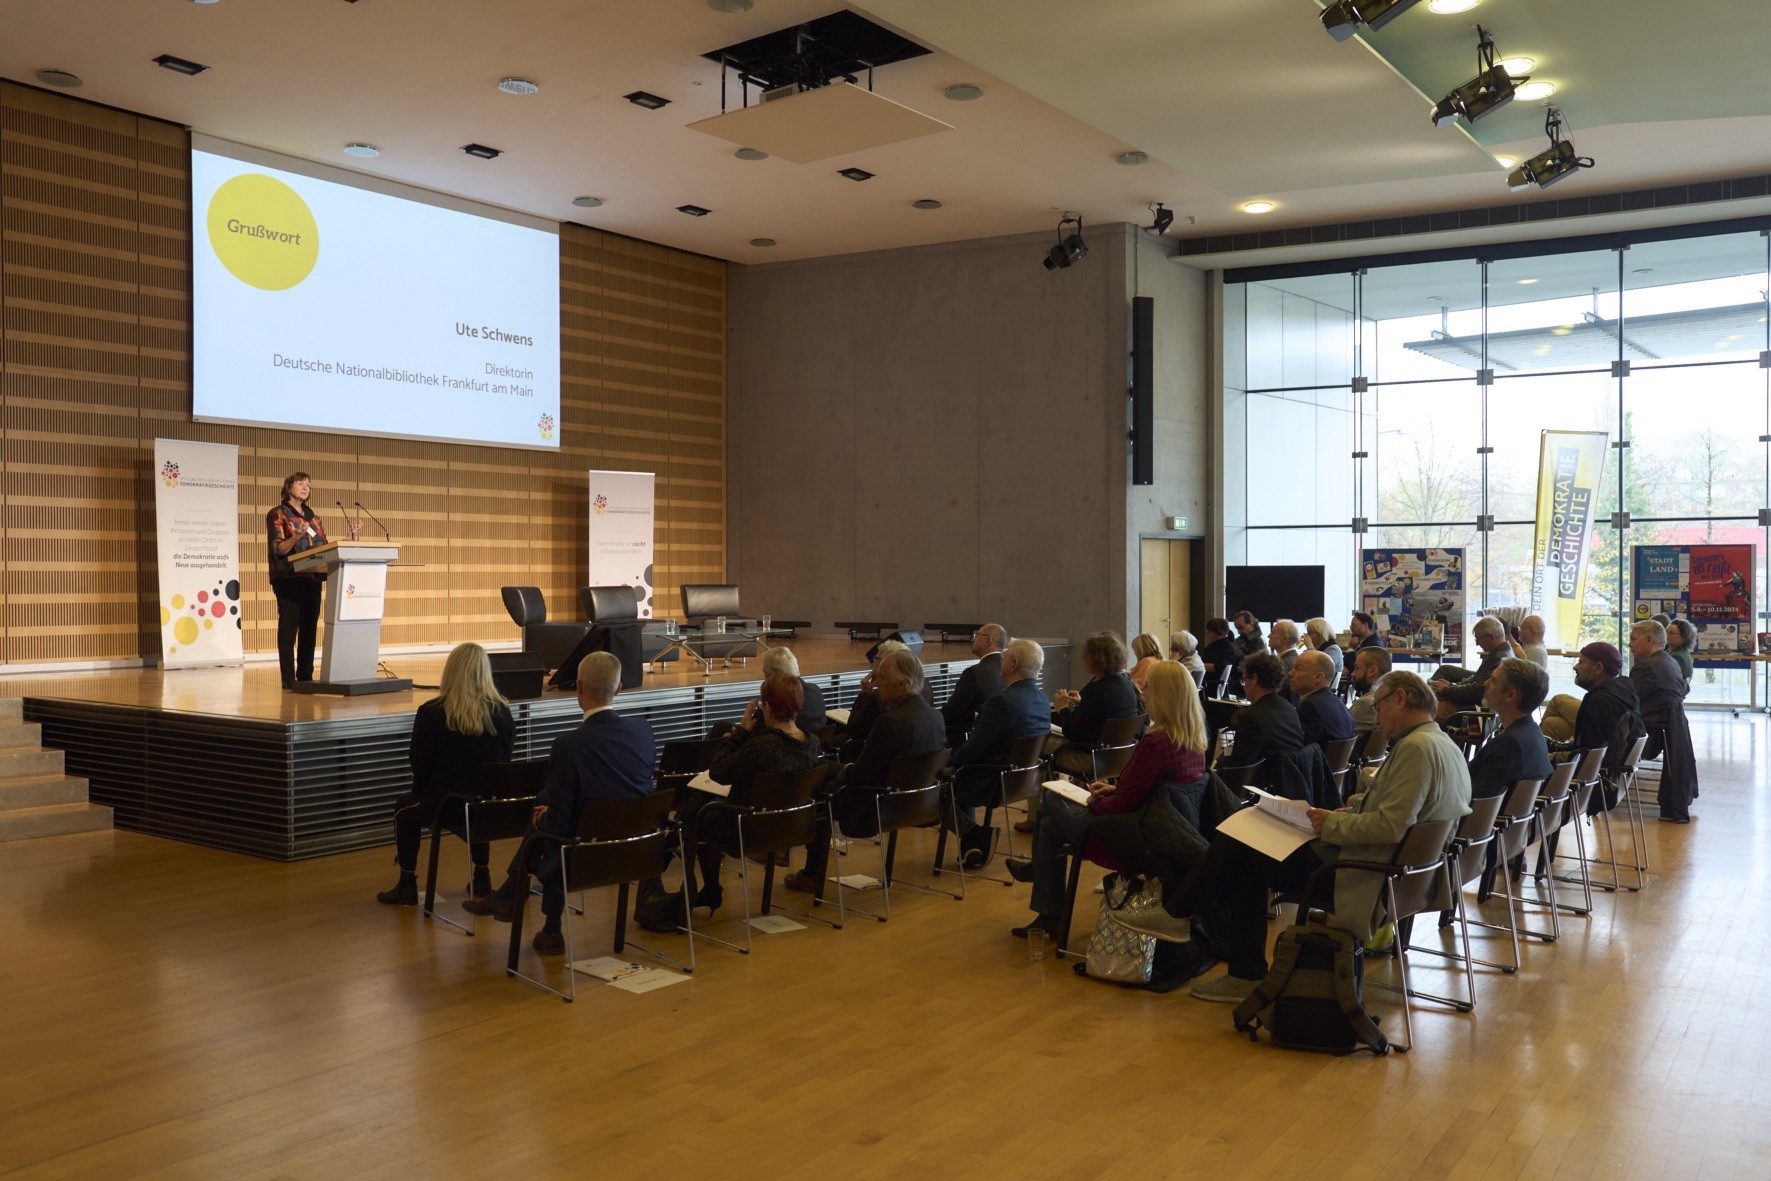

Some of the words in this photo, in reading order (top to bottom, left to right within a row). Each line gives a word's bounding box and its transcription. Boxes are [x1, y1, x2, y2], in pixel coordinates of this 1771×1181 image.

[227, 218, 302, 246] Grußwort
[455, 322, 478, 338] Ute
[481, 326, 534, 347] Schwens
[273, 353, 332, 374] Deutsche
[336, 362, 440, 387] Nationalbibliothek
[442, 375, 489, 393] Frankfurt
[491, 383, 508, 395] am
[510, 380, 534, 398] Main
[485, 362, 534, 380] Direktorin
[1550, 451, 1576, 564] DEMOKRATIE
[1538, 539, 1546, 560] DER
[1560, 491, 1588, 595] GESCHICHTE
[1535, 562, 1544, 584] ORT
[1533, 586, 1542, 611] DEIN
